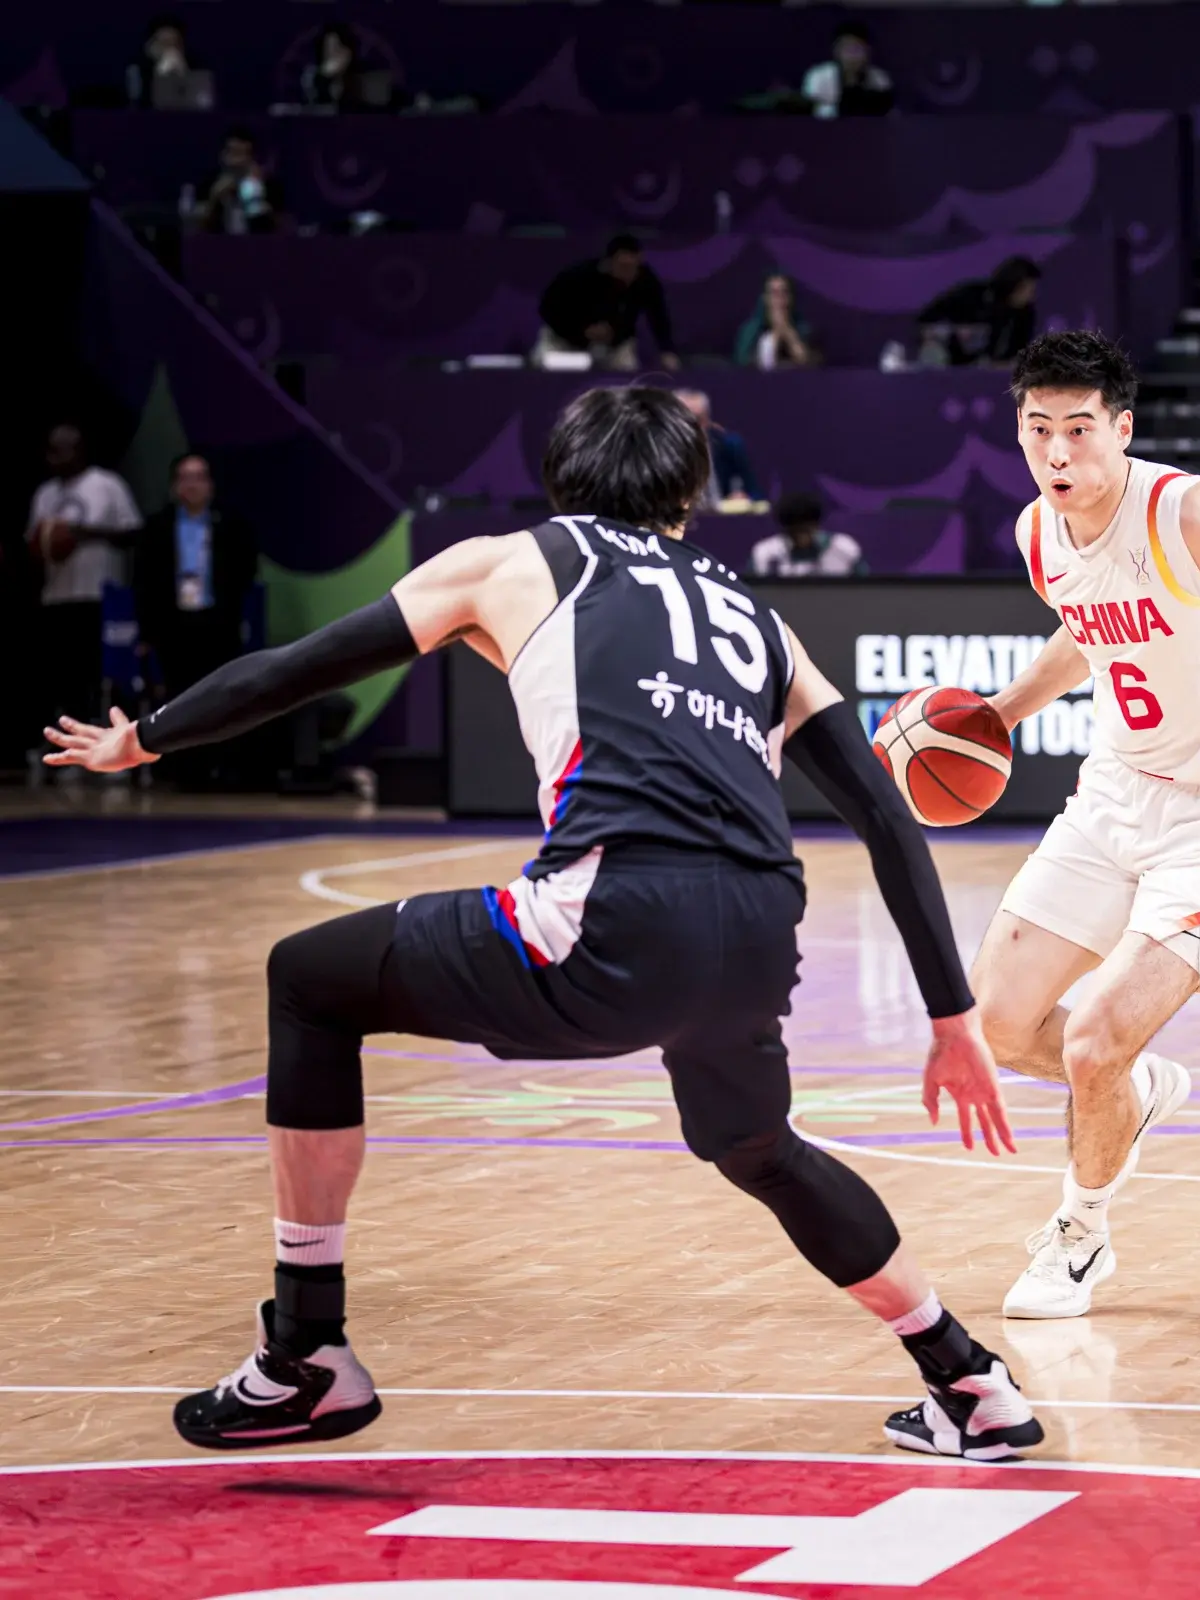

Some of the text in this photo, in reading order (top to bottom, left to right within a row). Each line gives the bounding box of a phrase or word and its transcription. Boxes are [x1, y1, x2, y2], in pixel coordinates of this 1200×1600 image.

[1060, 597, 1175, 646] CHINA
[855, 634, 1093, 696] ELEVATI
[1108, 661, 1164, 731] 6
